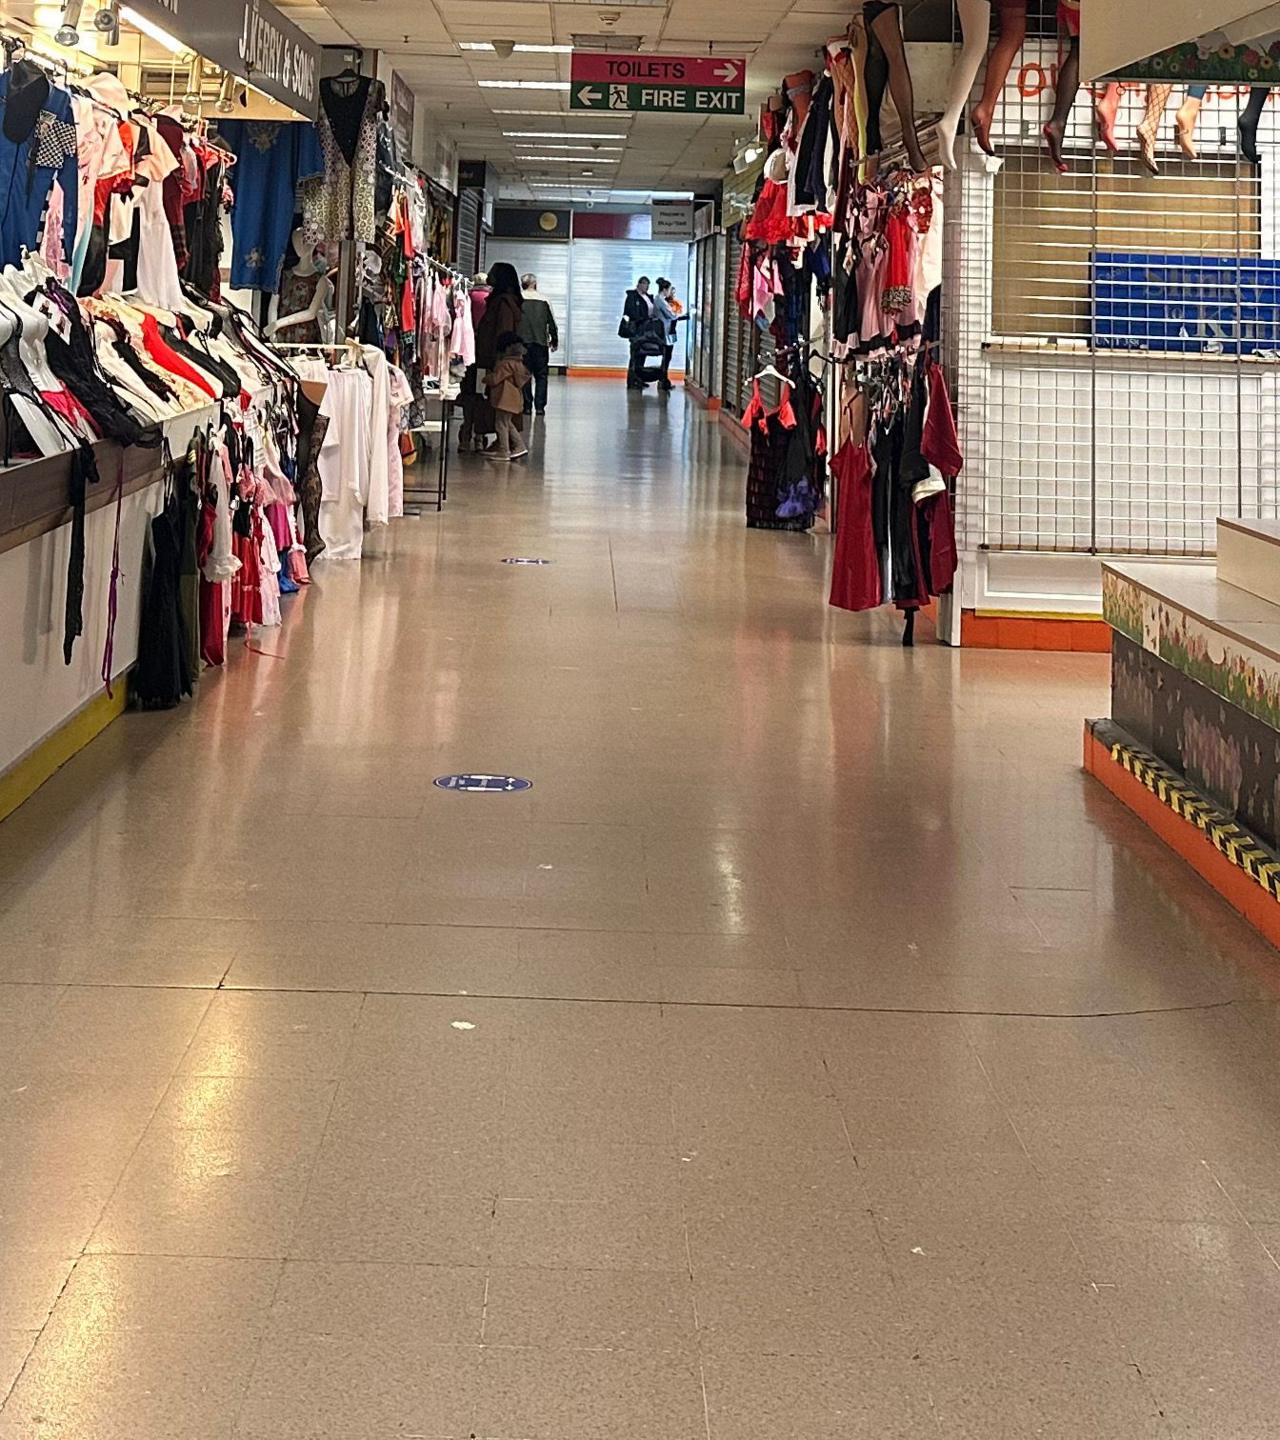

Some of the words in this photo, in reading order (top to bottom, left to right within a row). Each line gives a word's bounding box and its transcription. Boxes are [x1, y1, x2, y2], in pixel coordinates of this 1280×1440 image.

[282, 38, 291, 89] &
[292, 43, 315, 102] SONS
[607, 60, 686, 79] TOILETS
[641, 89, 687, 108] FIRE
[694, 91, 741, 110] EXIT
